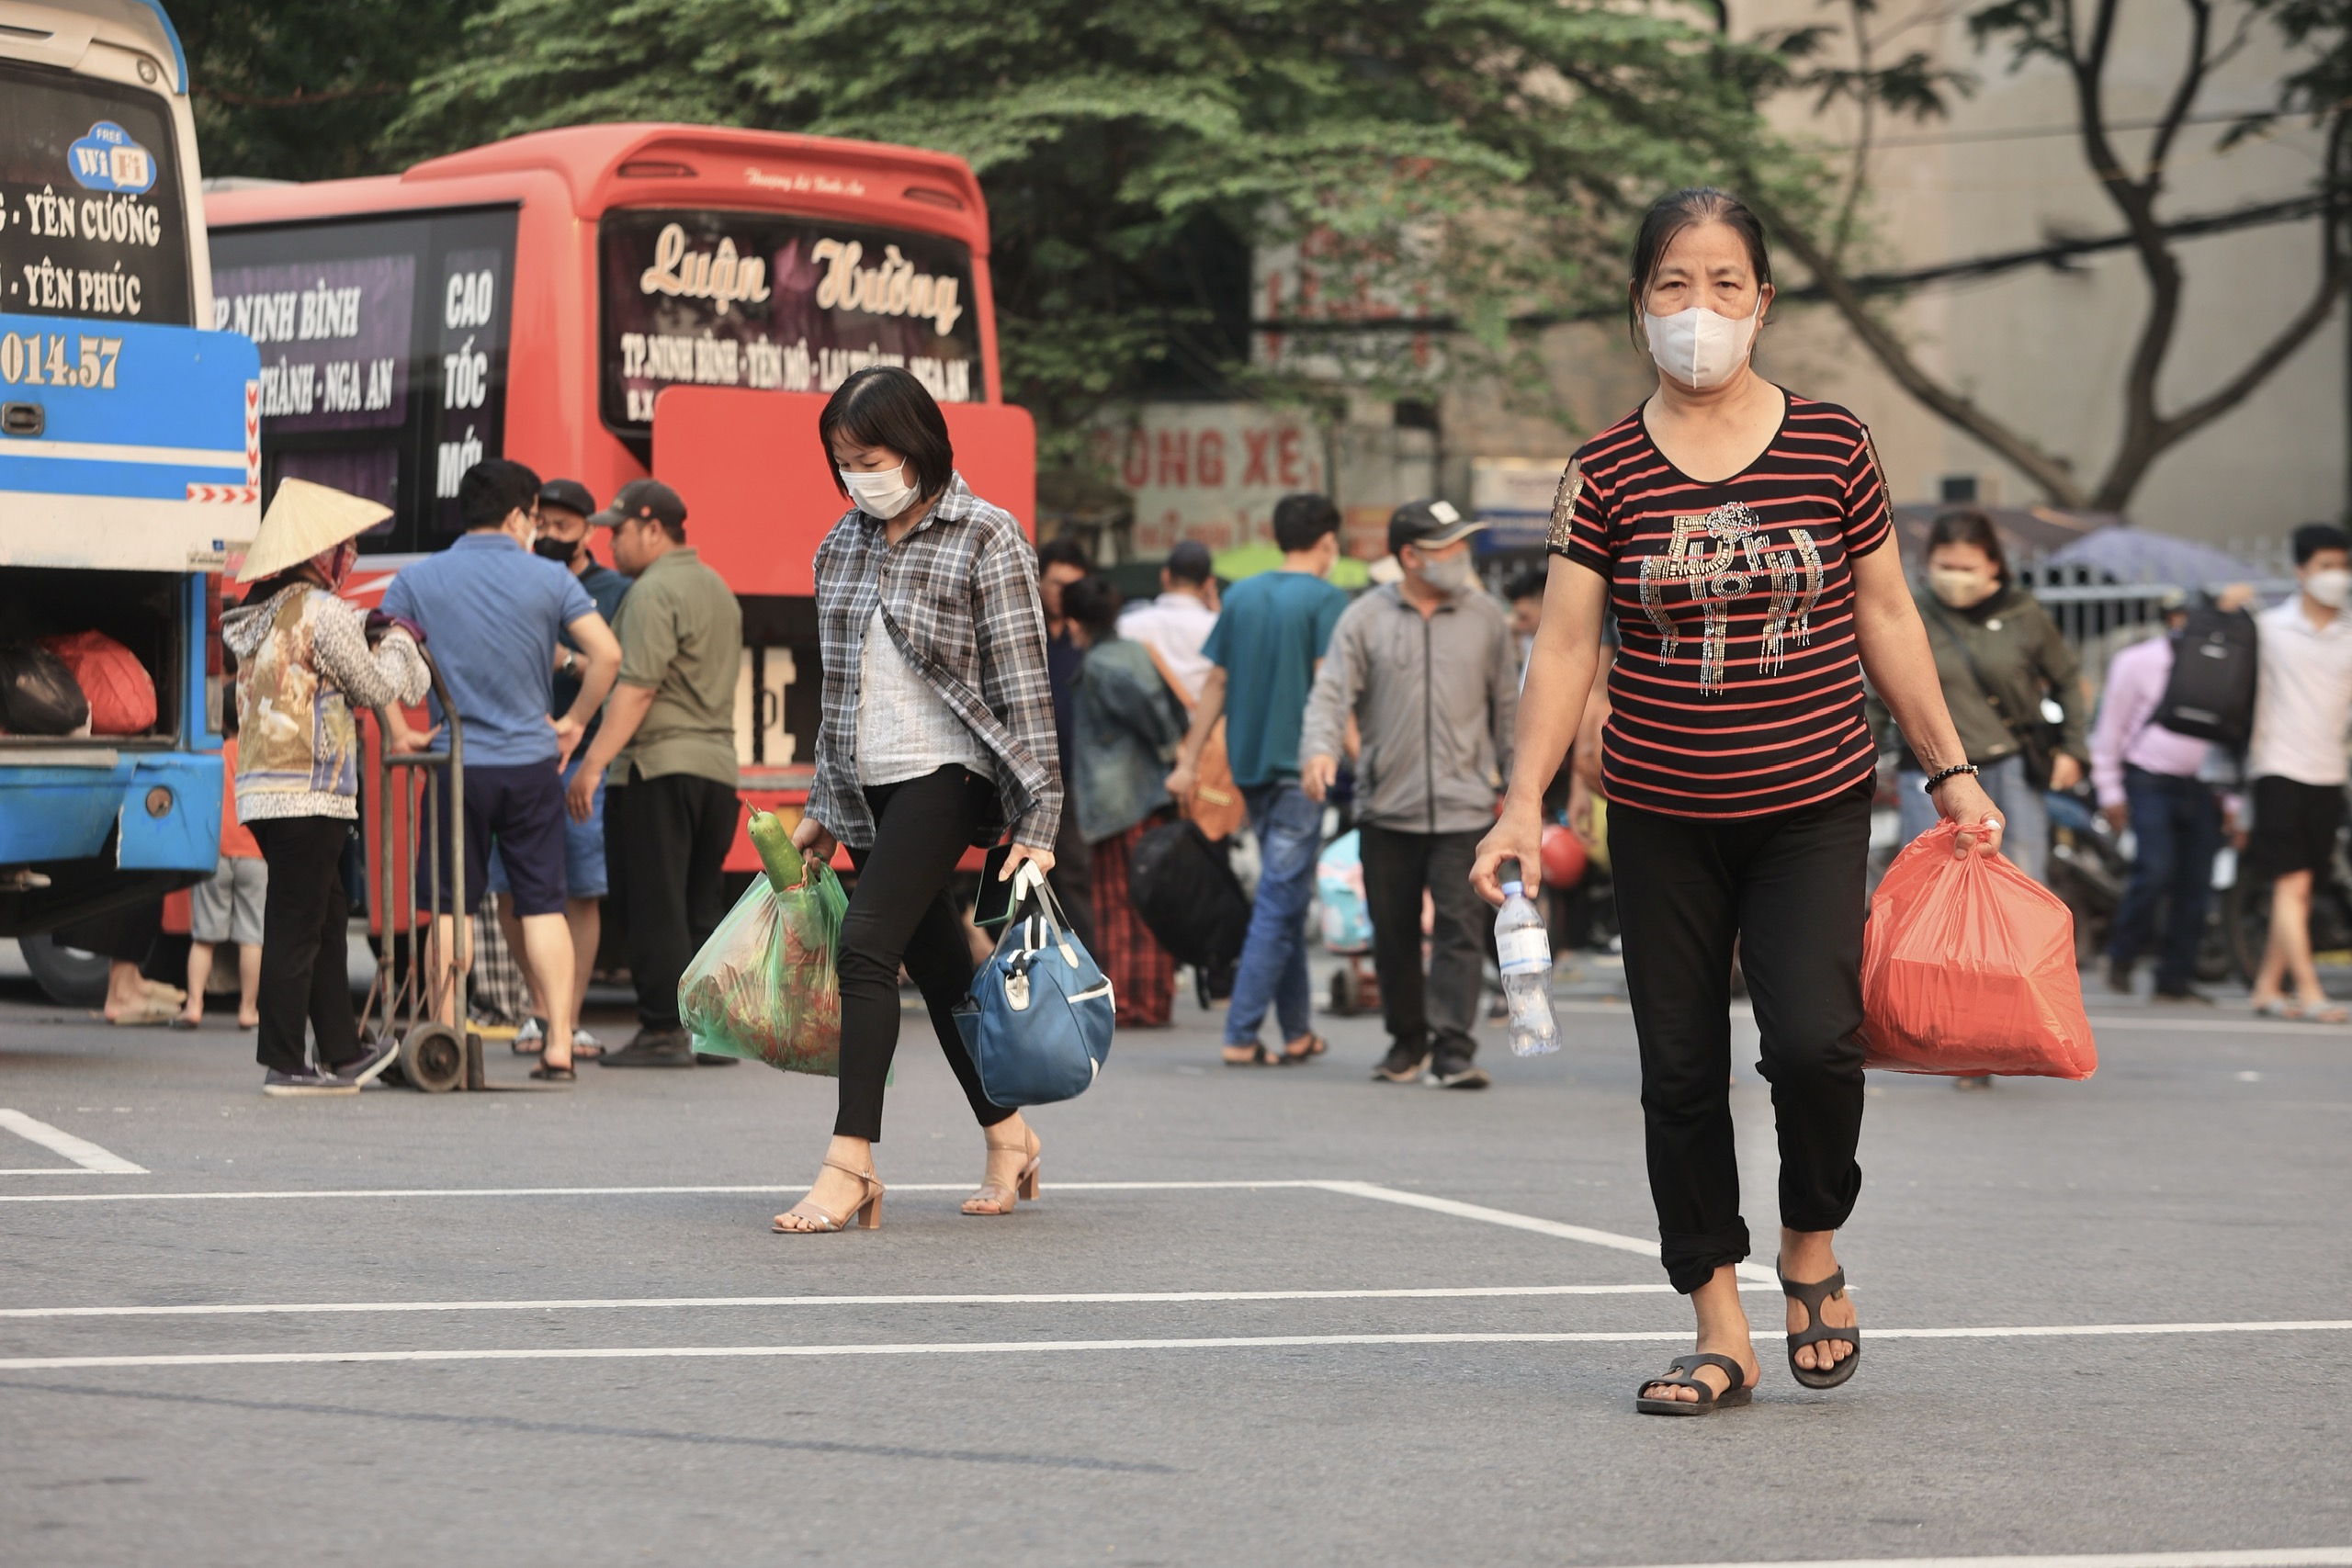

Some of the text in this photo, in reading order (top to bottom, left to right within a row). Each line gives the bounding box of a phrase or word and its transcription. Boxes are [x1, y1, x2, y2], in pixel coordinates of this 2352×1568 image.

[96, 128, 123, 144] FREE
[25, 183, 75, 238] YÊN
[23, 255, 74, 310] YÊN
[78, 260, 141, 315] PHÚC
[639, 222, 771, 316] Luận
[213, 276, 362, 344] P.NINH BÌNH
[445, 269, 494, 330] CAO
[0, 332, 123, 389] 014.57
[322, 359, 362, 413] NGA
[364, 357, 395, 412] AN
[444, 334, 488, 410] TỐC
[745, 332, 783, 389] YÊN
